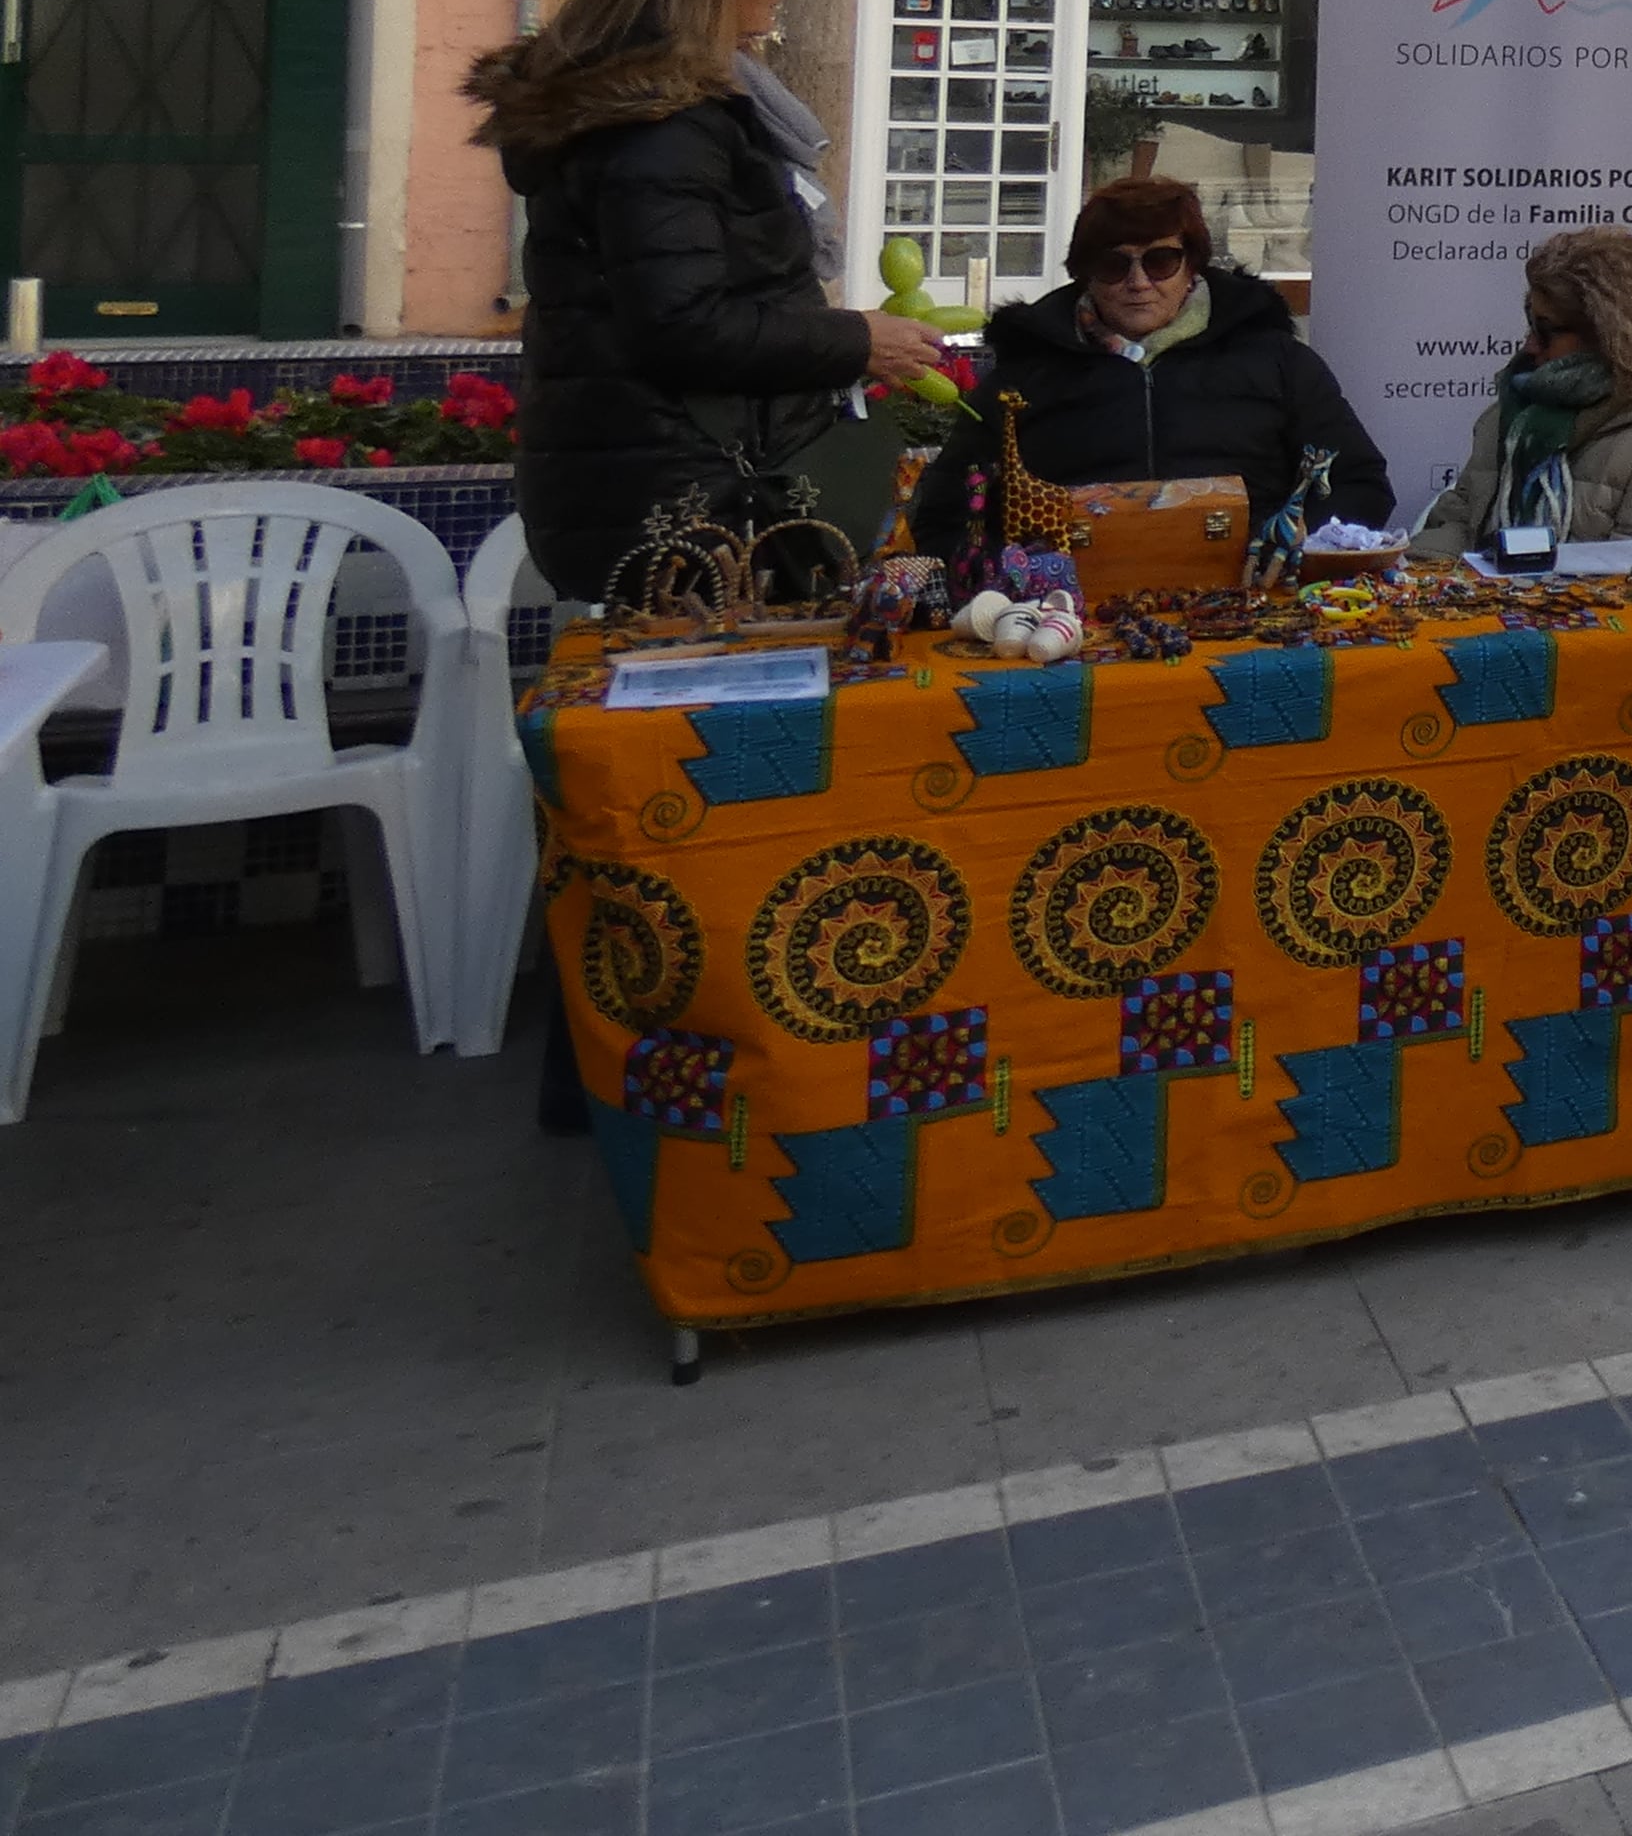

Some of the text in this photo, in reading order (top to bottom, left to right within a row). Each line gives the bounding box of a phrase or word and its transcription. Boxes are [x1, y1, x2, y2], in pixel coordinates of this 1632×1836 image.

[1396, 43, 1562, 68] SOLIDARIOS
[1576, 47, 1629, 69] POR
[1386, 167, 1457, 188] KARIT
[1462, 167, 1602, 189] SOLIDARIOS
[1387, 204, 1460, 225] ONGD
[1467, 204, 1496, 224] de
[1503, 204, 1522, 224] la
[1529, 205, 1615, 225] Familia
[1393, 240, 1508, 261] Declarada
[1384, 376, 1499, 400] secretaria
